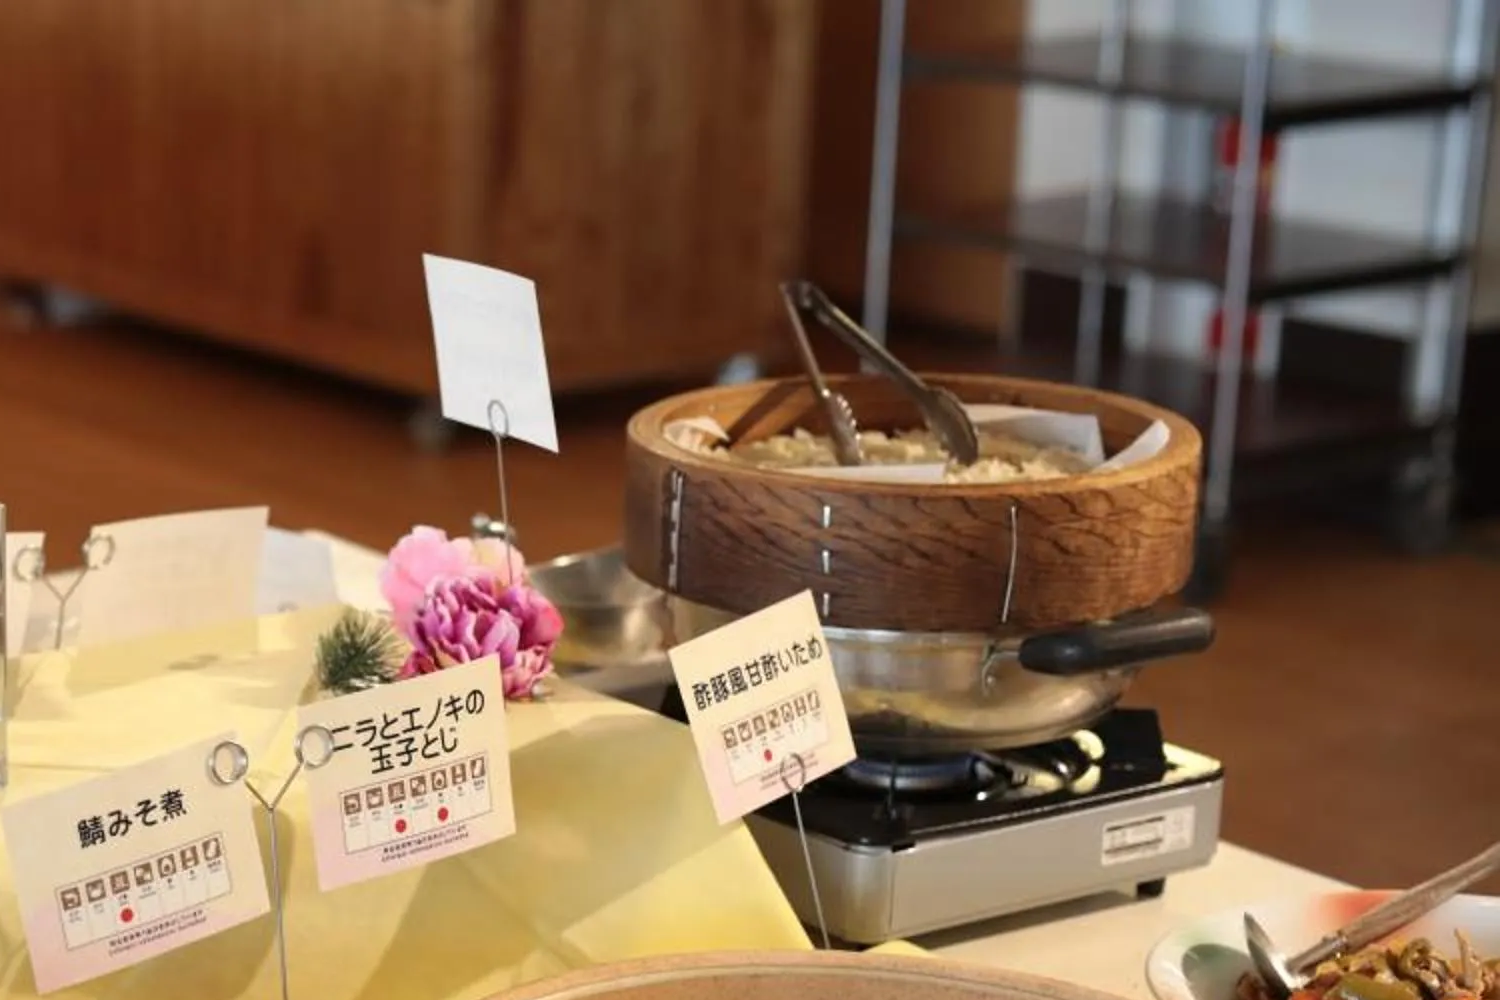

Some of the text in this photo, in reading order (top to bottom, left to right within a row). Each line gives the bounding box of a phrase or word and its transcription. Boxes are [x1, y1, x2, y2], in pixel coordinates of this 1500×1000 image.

[691, 637, 823, 710] 酢豚風甘酢いため
[331, 688, 485, 752] ニラとエノキの
[370, 726, 458, 774] 玉子とじ
[77, 789, 187, 848] 鯖みそ煮
